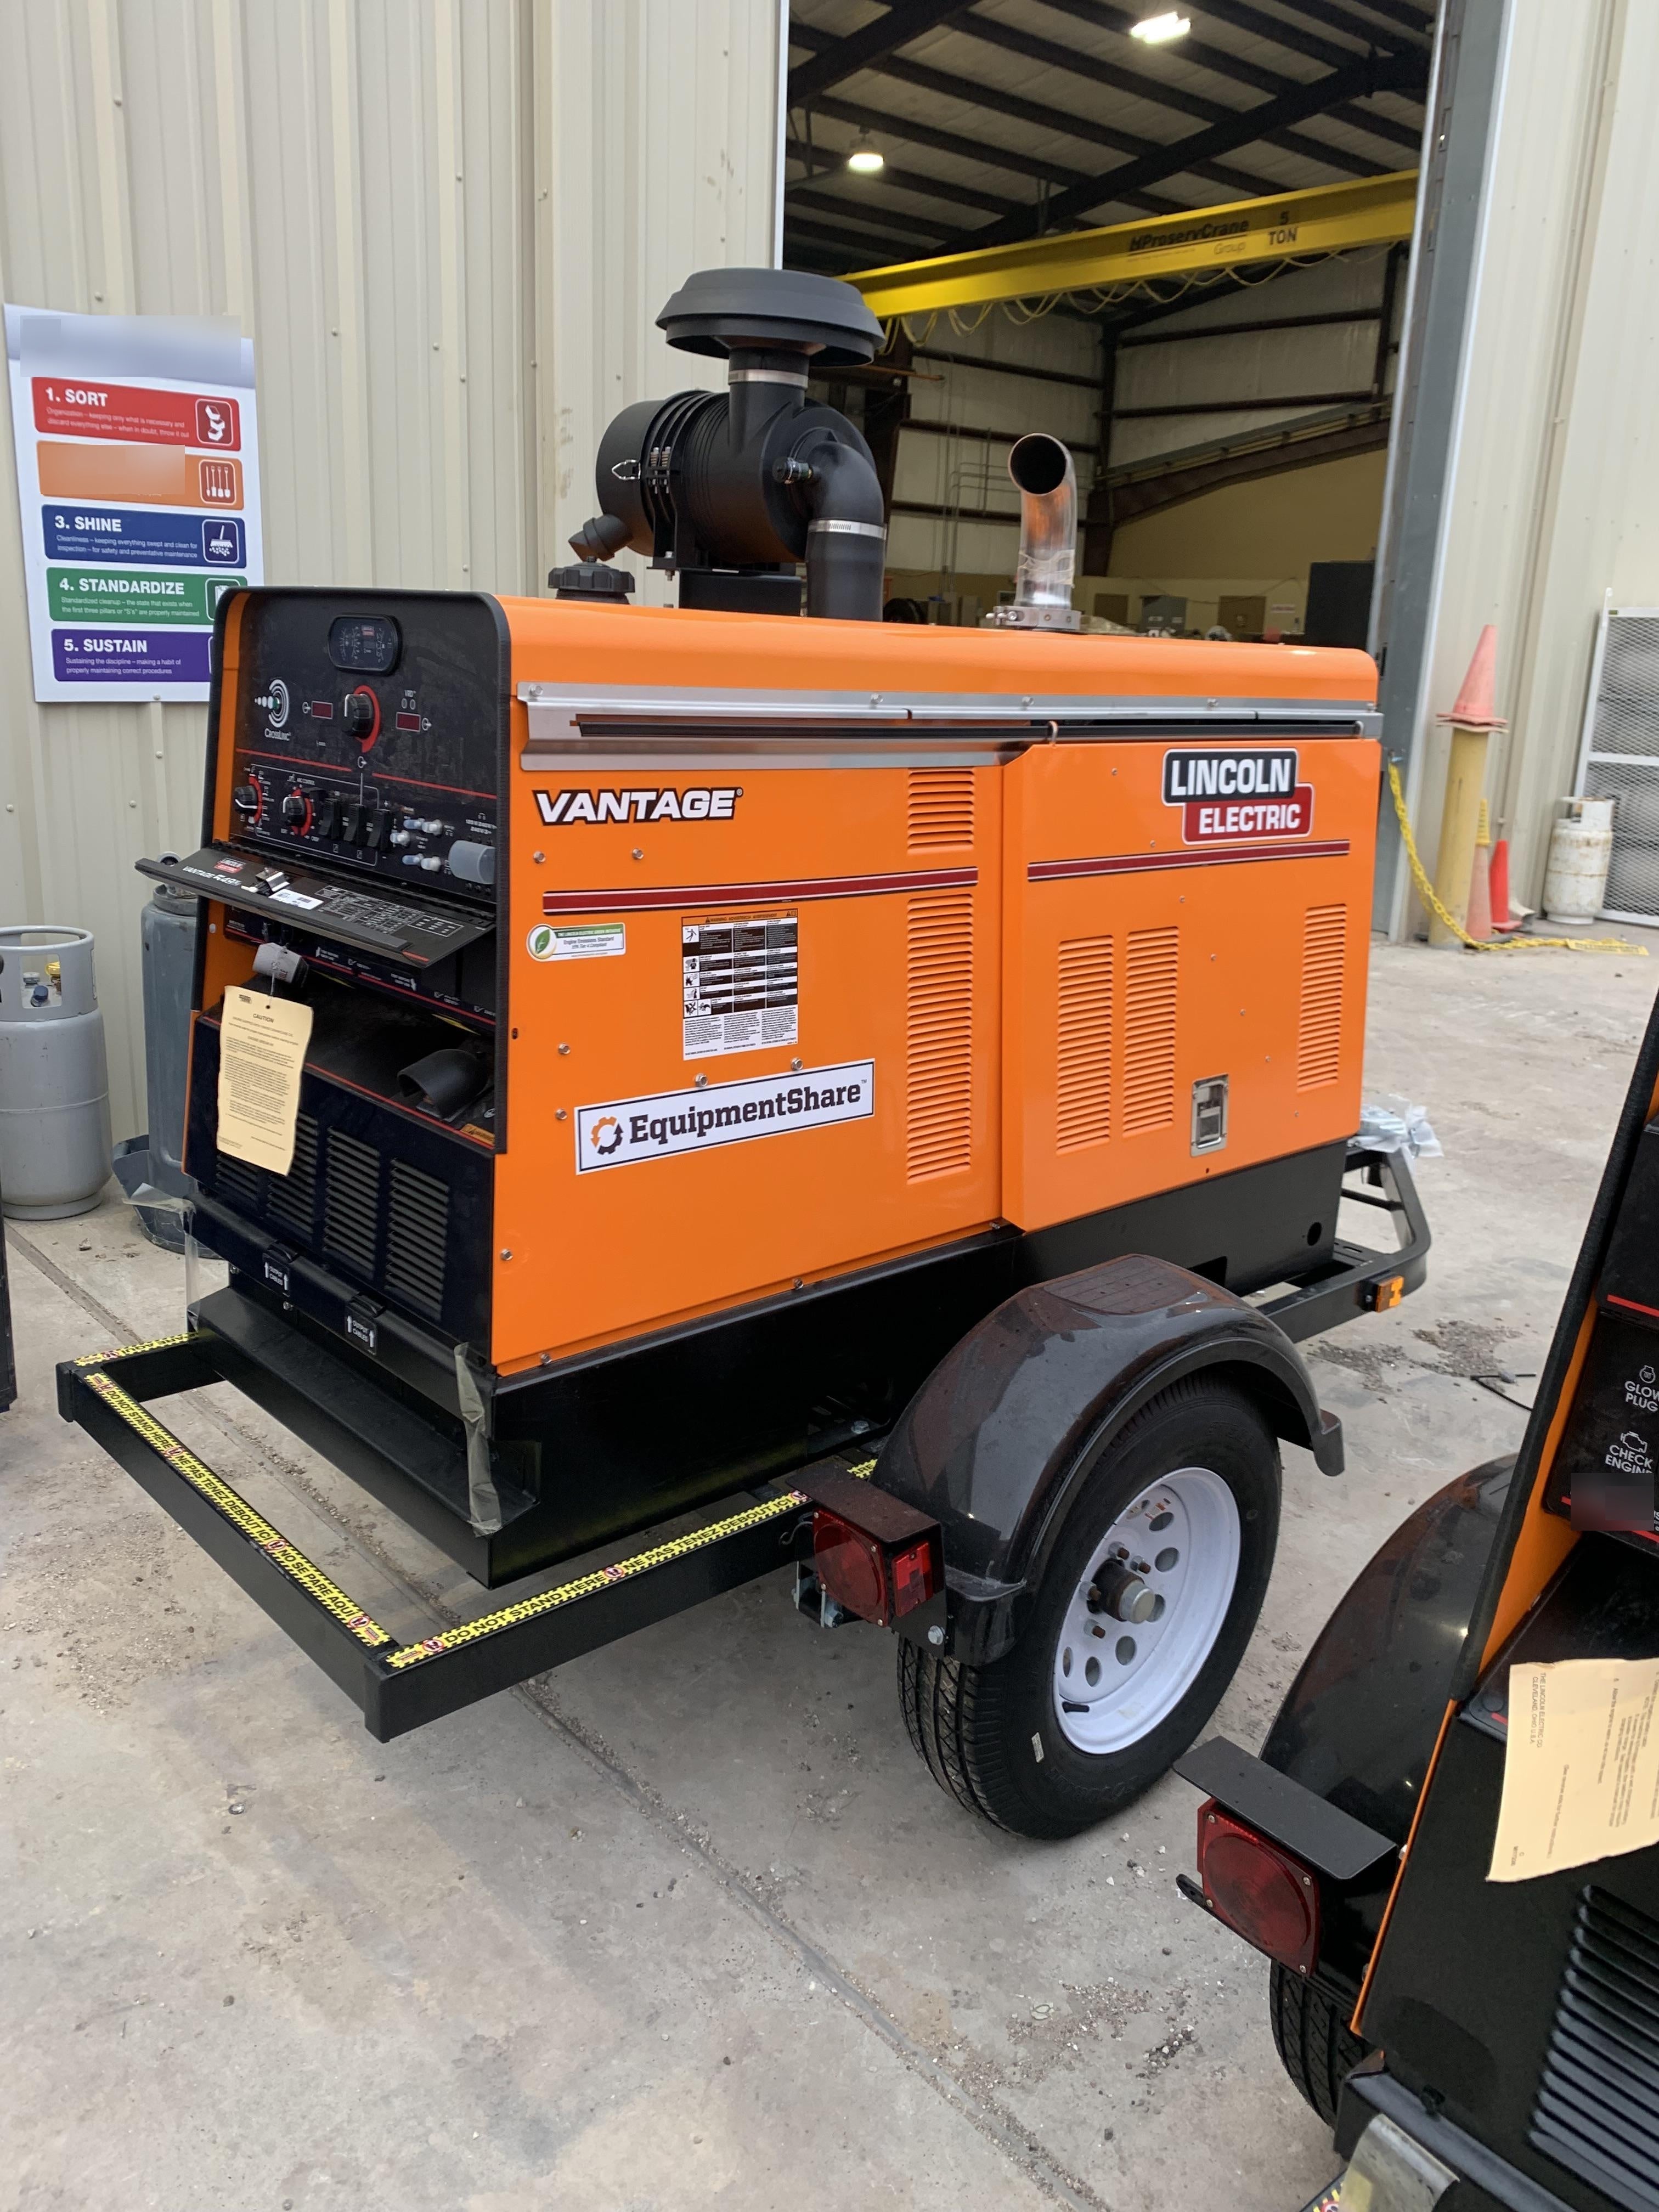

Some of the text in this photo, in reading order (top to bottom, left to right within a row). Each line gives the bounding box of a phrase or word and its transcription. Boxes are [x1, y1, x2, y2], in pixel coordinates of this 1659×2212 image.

[1280, 210, 1290, 225] 5
[1268, 227, 1297, 245] TON
[46, 387, 108, 407] 1. SORT
[55, 515, 122, 532] 3. SHINE
[59, 577, 185, 595] 4. STANDARDIZE
[64, 638, 148, 653] 5. SUSTAIN
[1171, 758, 1291, 796] LINCOLN
[1199, 803, 1301, 834] ELECTRIC
[182, 866, 216, 878] VANTAGE
[253, 1013, 274, 1024] CAUTION
[1625, 1392, 1658, 1412] PLUG
[1609, 1444, 1653, 1470] CHECK
[106, 1390, 358, 1617] DO NOT STAND HERE NE PAS TENEZ DEBOUT ICI NO SE PARE AQUI
[443, 1629, 471, 1644] DO
[473, 1614, 509, 1632] NOT
[508, 1592, 563, 1617] STAND
[565, 1574, 606, 1594] HERE
[623, 1559, 647, 1570] NE
[645, 1547, 675, 1562] PAS
[676, 1528, 723, 1548] TENEZ
[719, 1506, 774, 1531] DEBOUT
[774, 1498, 793, 1509] ICI
[1530, 1676, 1538, 1712] CLEVELAND,
[1537, 1711, 1545, 1739] ELECTRIC
